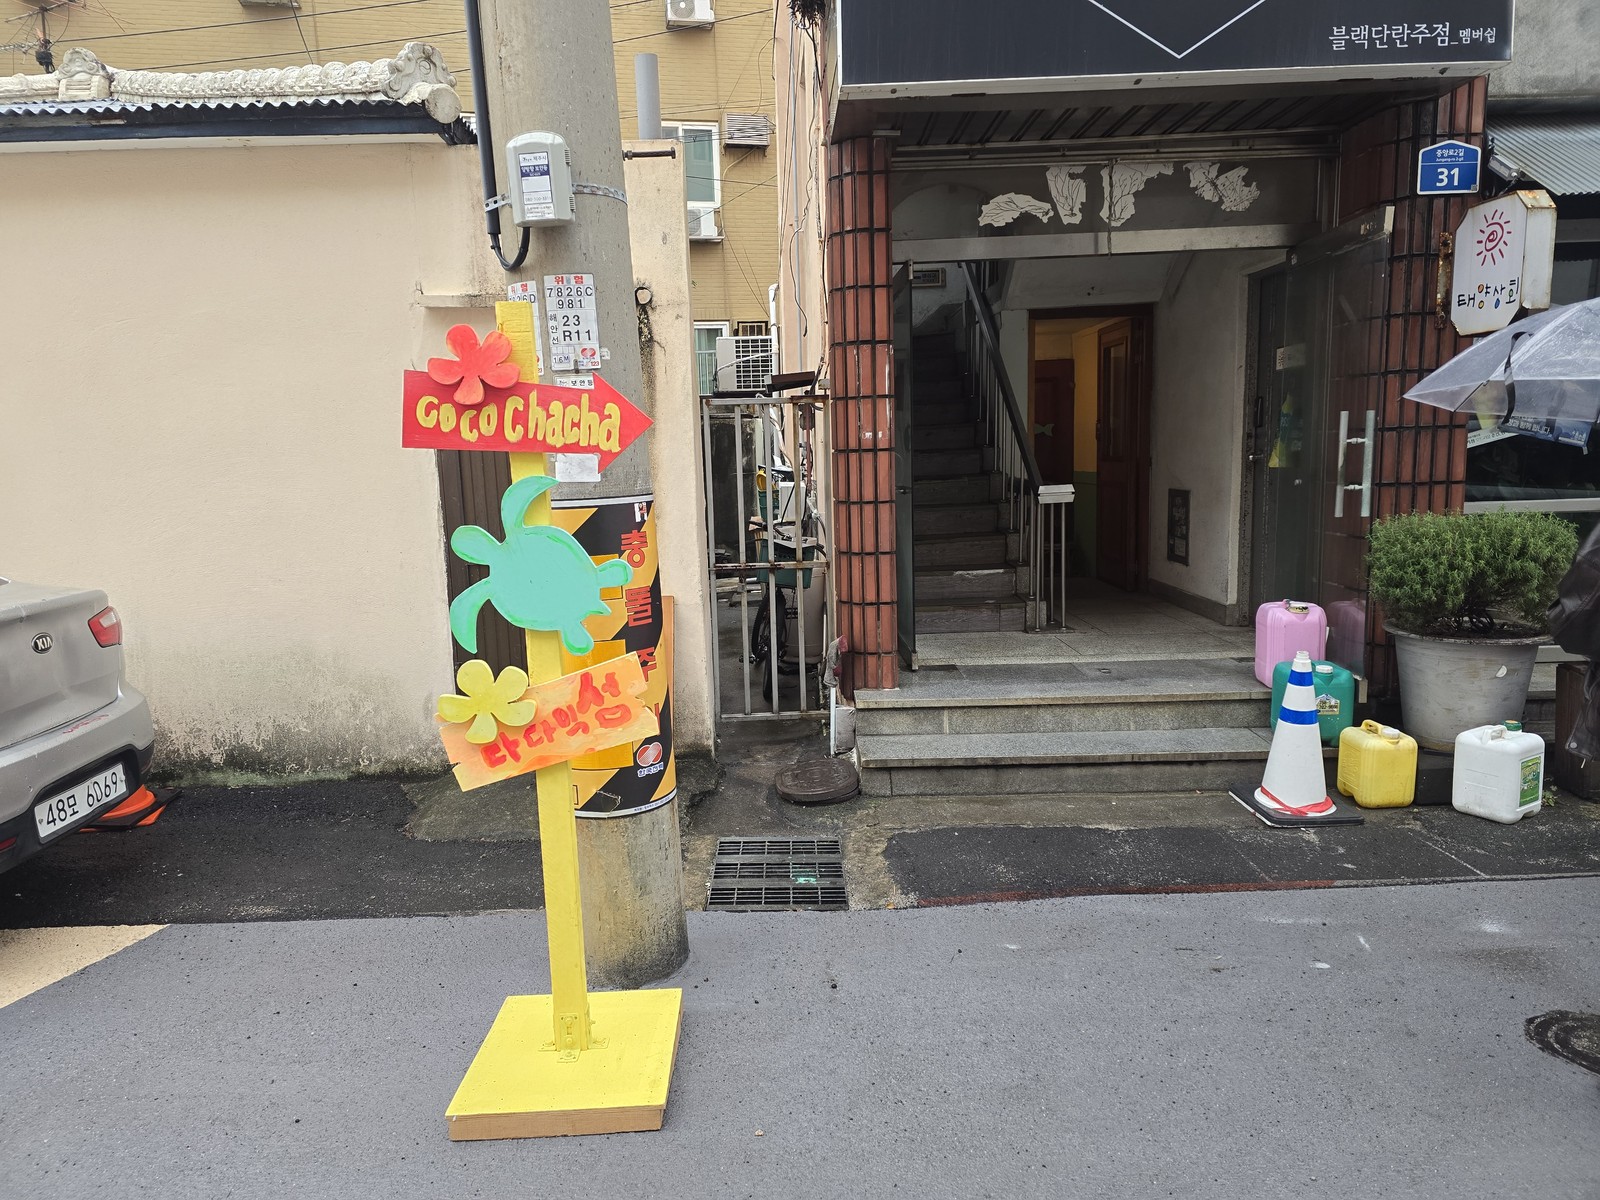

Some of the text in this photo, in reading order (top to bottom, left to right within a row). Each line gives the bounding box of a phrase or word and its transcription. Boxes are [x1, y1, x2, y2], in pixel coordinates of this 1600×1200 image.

[1436, 148, 1465, 158] 중앙로2길
[1436, 167, 1459, 187] 31
[547, 286, 593, 297] 7826C
[1457, 277, 1520, 309] 태양상회
[557, 299, 584, 309] 981
[562, 315, 581, 327] 23
[563, 329, 591, 342] R11
[504, 389, 621, 453] Chacha
[36, 638, 53, 651] KIA
[46, 772, 118, 827] 48모 6069
